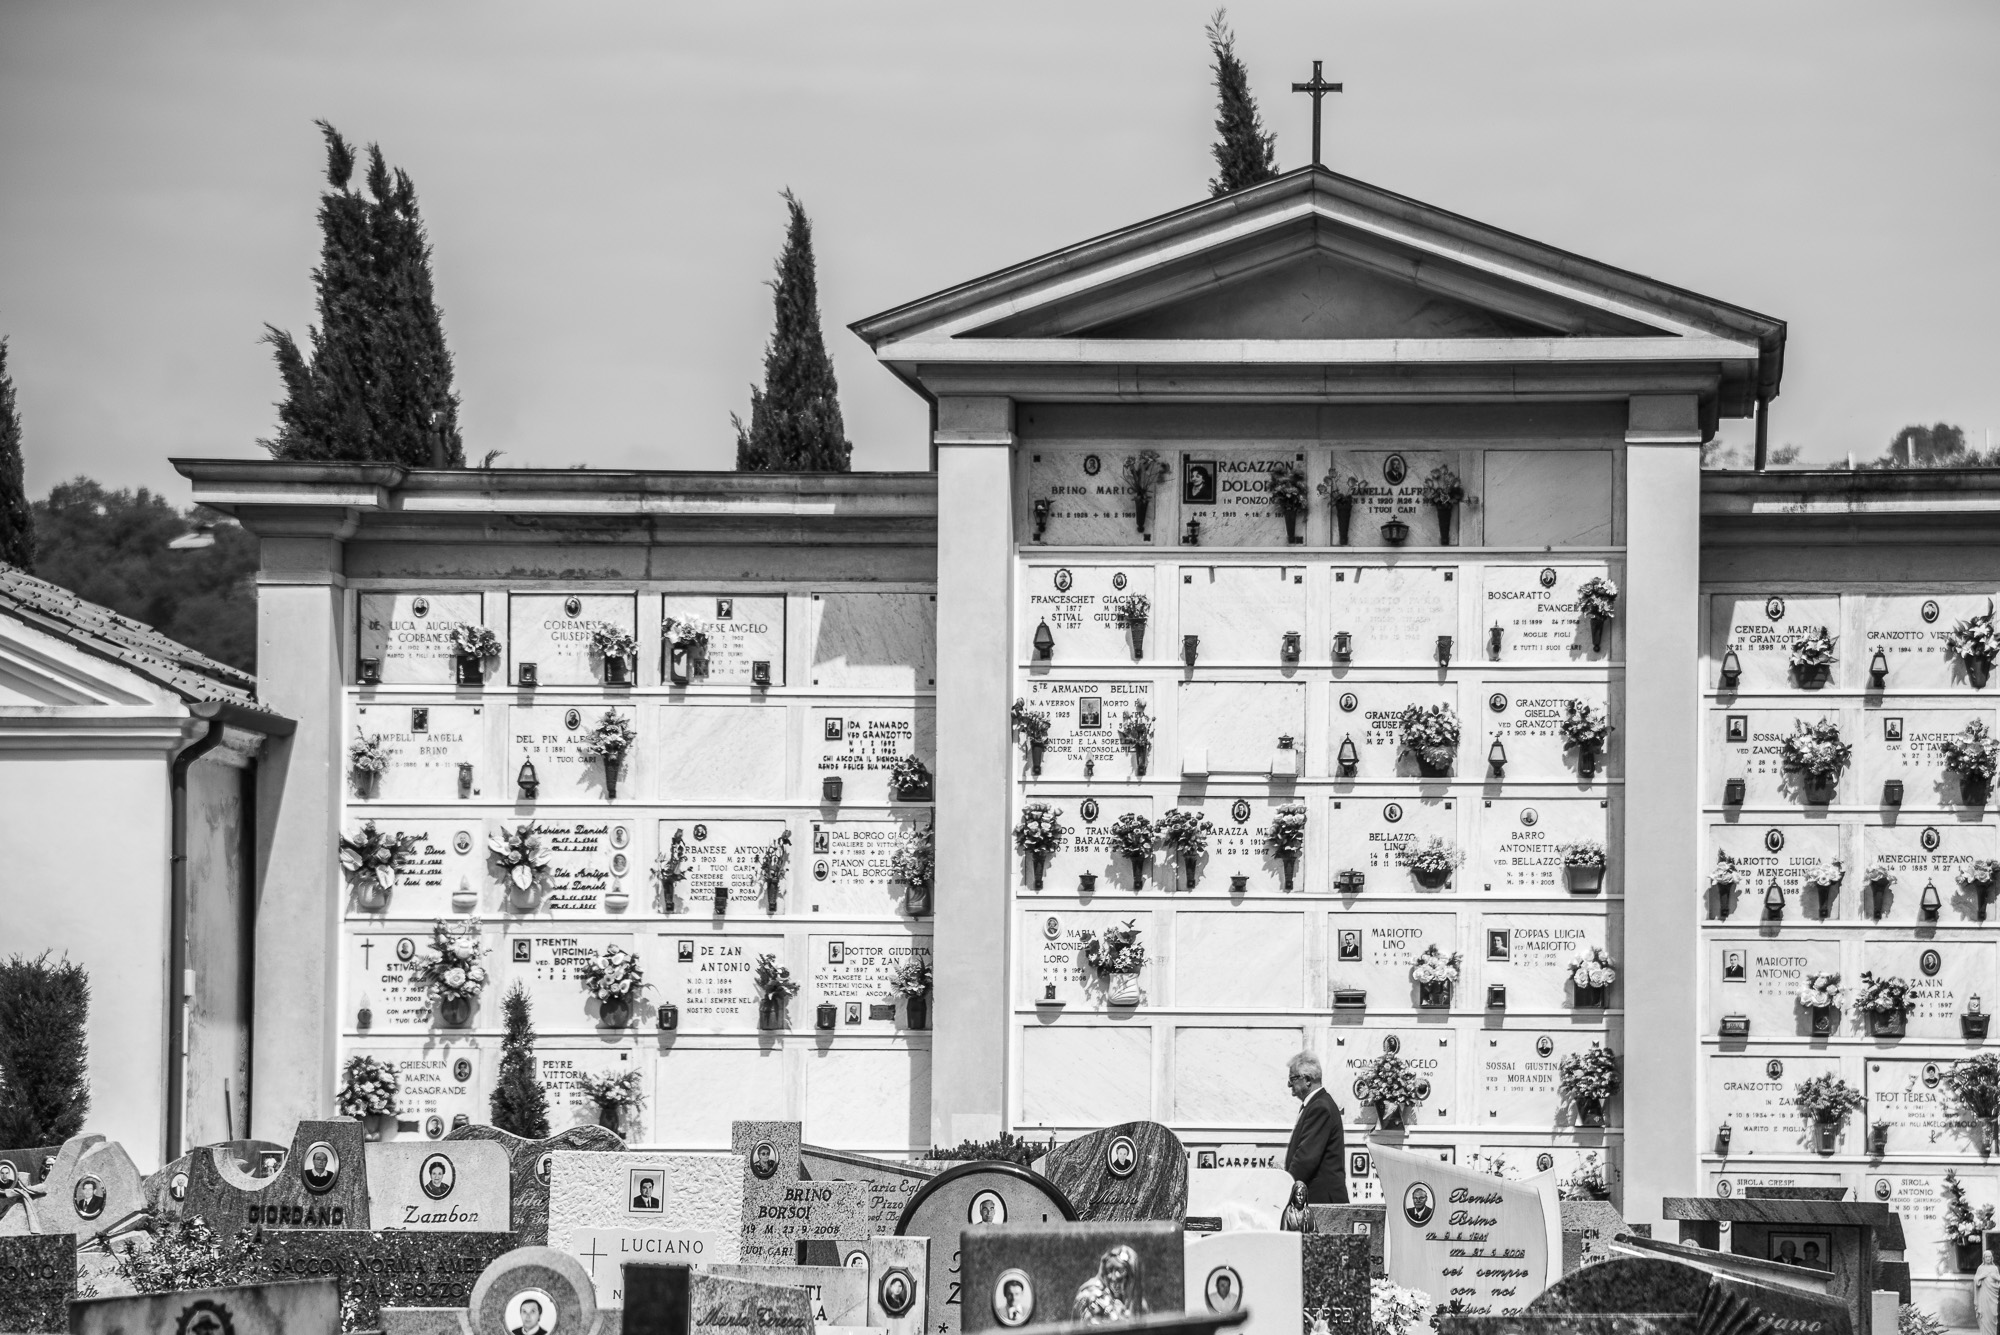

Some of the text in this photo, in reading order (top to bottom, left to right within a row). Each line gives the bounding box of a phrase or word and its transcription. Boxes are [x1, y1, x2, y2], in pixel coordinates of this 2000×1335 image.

[1052, 486, 1086, 495] BRINO
[1375, 506, 1416, 514] TUOI CARI
[1030, 596, 1095, 604] FRANCESCHET
[1488, 591, 1551, 600] BOSCARATTO
[1052, 613, 1083, 622] STIVAL
[390, 621, 416, 630] LUCA
[728, 624, 768, 633] ANGELO
[1734, 626, 1816, 634] CENEDA MARIA
[1867, 631, 1924, 640] GRANZOTTO
[1051, 685, 1148, 694] ARMANDO BELLINI
[1524, 710, 1560, 718] GISELDA
[847, 721, 909, 730] IDA ZANARDO
[427, 734, 464, 742] ANGELA
[516, 735, 558, 744] DEL PIN
[863, 731, 912, 740] GRANZOTTO
[420, 747, 448, 755] BRINO
[832, 832, 884, 840] DAL BORGO
[1368, 832, 1416, 842] BELLAZZO
[1511, 832, 1545, 840] BARRO
[1499, 844, 1560, 853] ANTONIETTA
[832, 859, 864, 867] PIANON
[1511, 858, 1562, 866] BELLAZZO
[1790, 858, 1822, 866] LUIGIA
[1878, 855, 1973, 864] MENEGHIN STEFANO
[710, 864, 752, 872] TUOI CARI
[841, 868, 858, 876] DAL
[1371, 928, 1423, 939] MARIOTTO
[1514, 929, 1586, 939] ZOPPAS LUIGIA
[535, 938, 578, 947] TRENTIN
[1382, 940, 1406, 949] LINO
[1526, 941, 1576, 950] MARIOTTO
[700, 946, 742, 956] DE ZAN
[844, 947, 930, 956] DOTTOR GIUDITTA
[862, 958, 900, 966] DE ZAN
[1044, 955, 1069, 963] LORO
[1756, 957, 1808, 967] MARIOTTO
[700, 962, 751, 972] ANTONIO
[1756, 969, 1801, 979] ANTONIO
[1910, 979, 1943, 988] ZANIN
[400, 1061, 447, 1070] CHIESURIN
[543, 1061, 573, 1069] PEYRE
[1486, 1062, 1516, 1071] SOSSAI
[405, 1074, 440, 1082] MARINA
[1507, 1074, 1552, 1083] MORANDIN
[405, 1086, 466, 1095] CASAGRANDE
[1724, 1082, 1783, 1091] GRANZOTTO
[1876, 1092, 1936, 1102] TEOT TERESA
[1736, 1178, 1764, 1186] SIROLA
[785, 1188, 832, 1201] BRINO
[250, 1205, 344, 1225] GIORDANO
[403, 1205, 479, 1224] Zambon
[758, 1206, 811, 1219] BORSOI
[1449, 1210, 1498, 1226] Brino
[621, 1238, 704, 1254] LUCIANO
